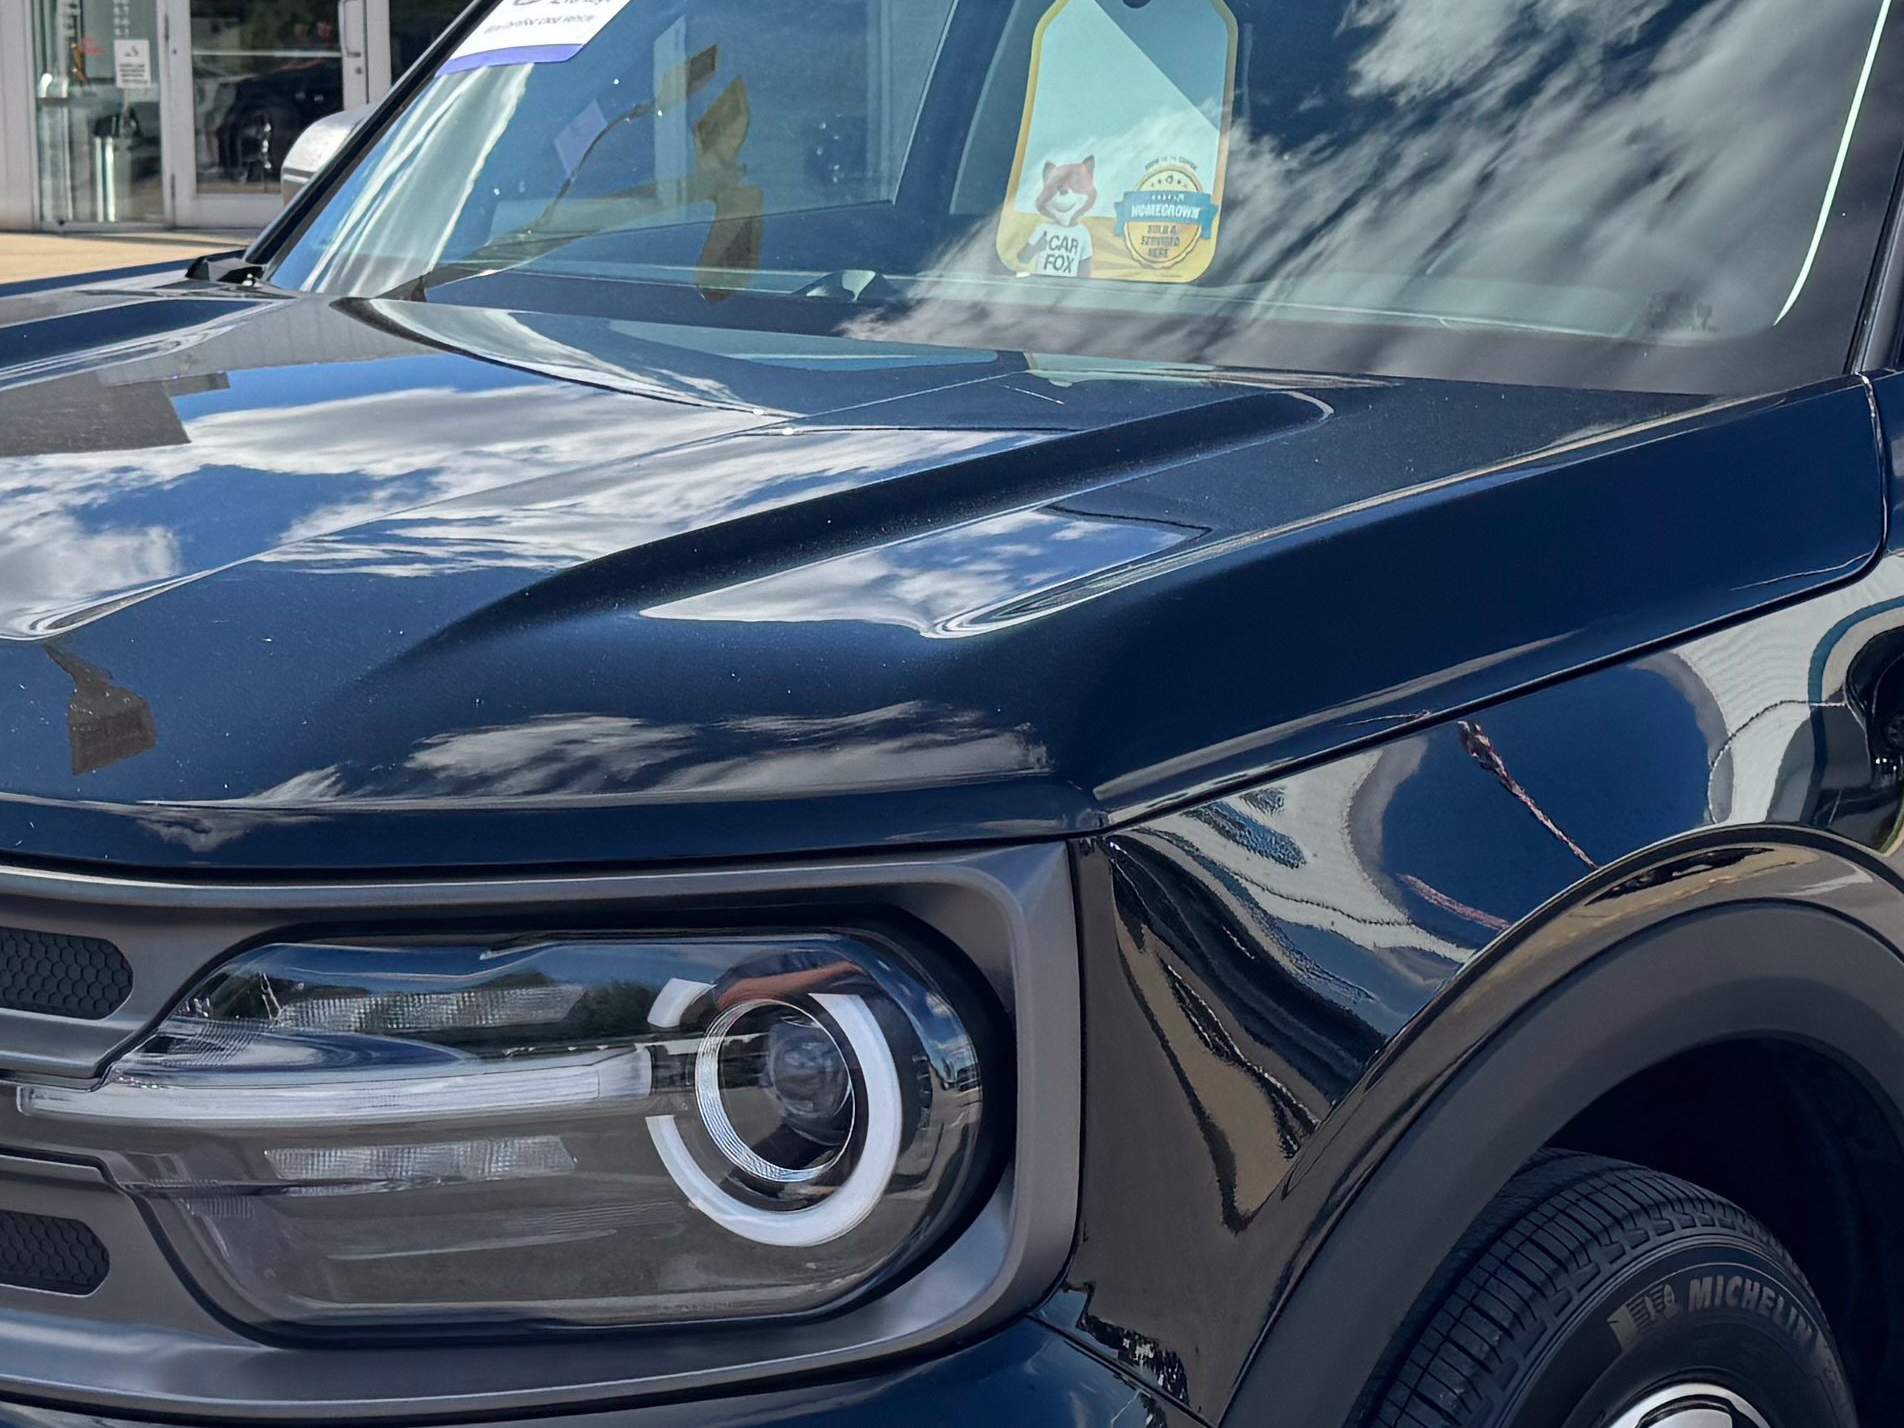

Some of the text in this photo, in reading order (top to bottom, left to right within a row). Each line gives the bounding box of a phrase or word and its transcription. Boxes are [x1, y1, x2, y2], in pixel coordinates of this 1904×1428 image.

[1048, 234, 1079, 255] CAR
[1043, 253, 1075, 273] FOX
[1687, 1275, 1813, 1342] MICHELIN
